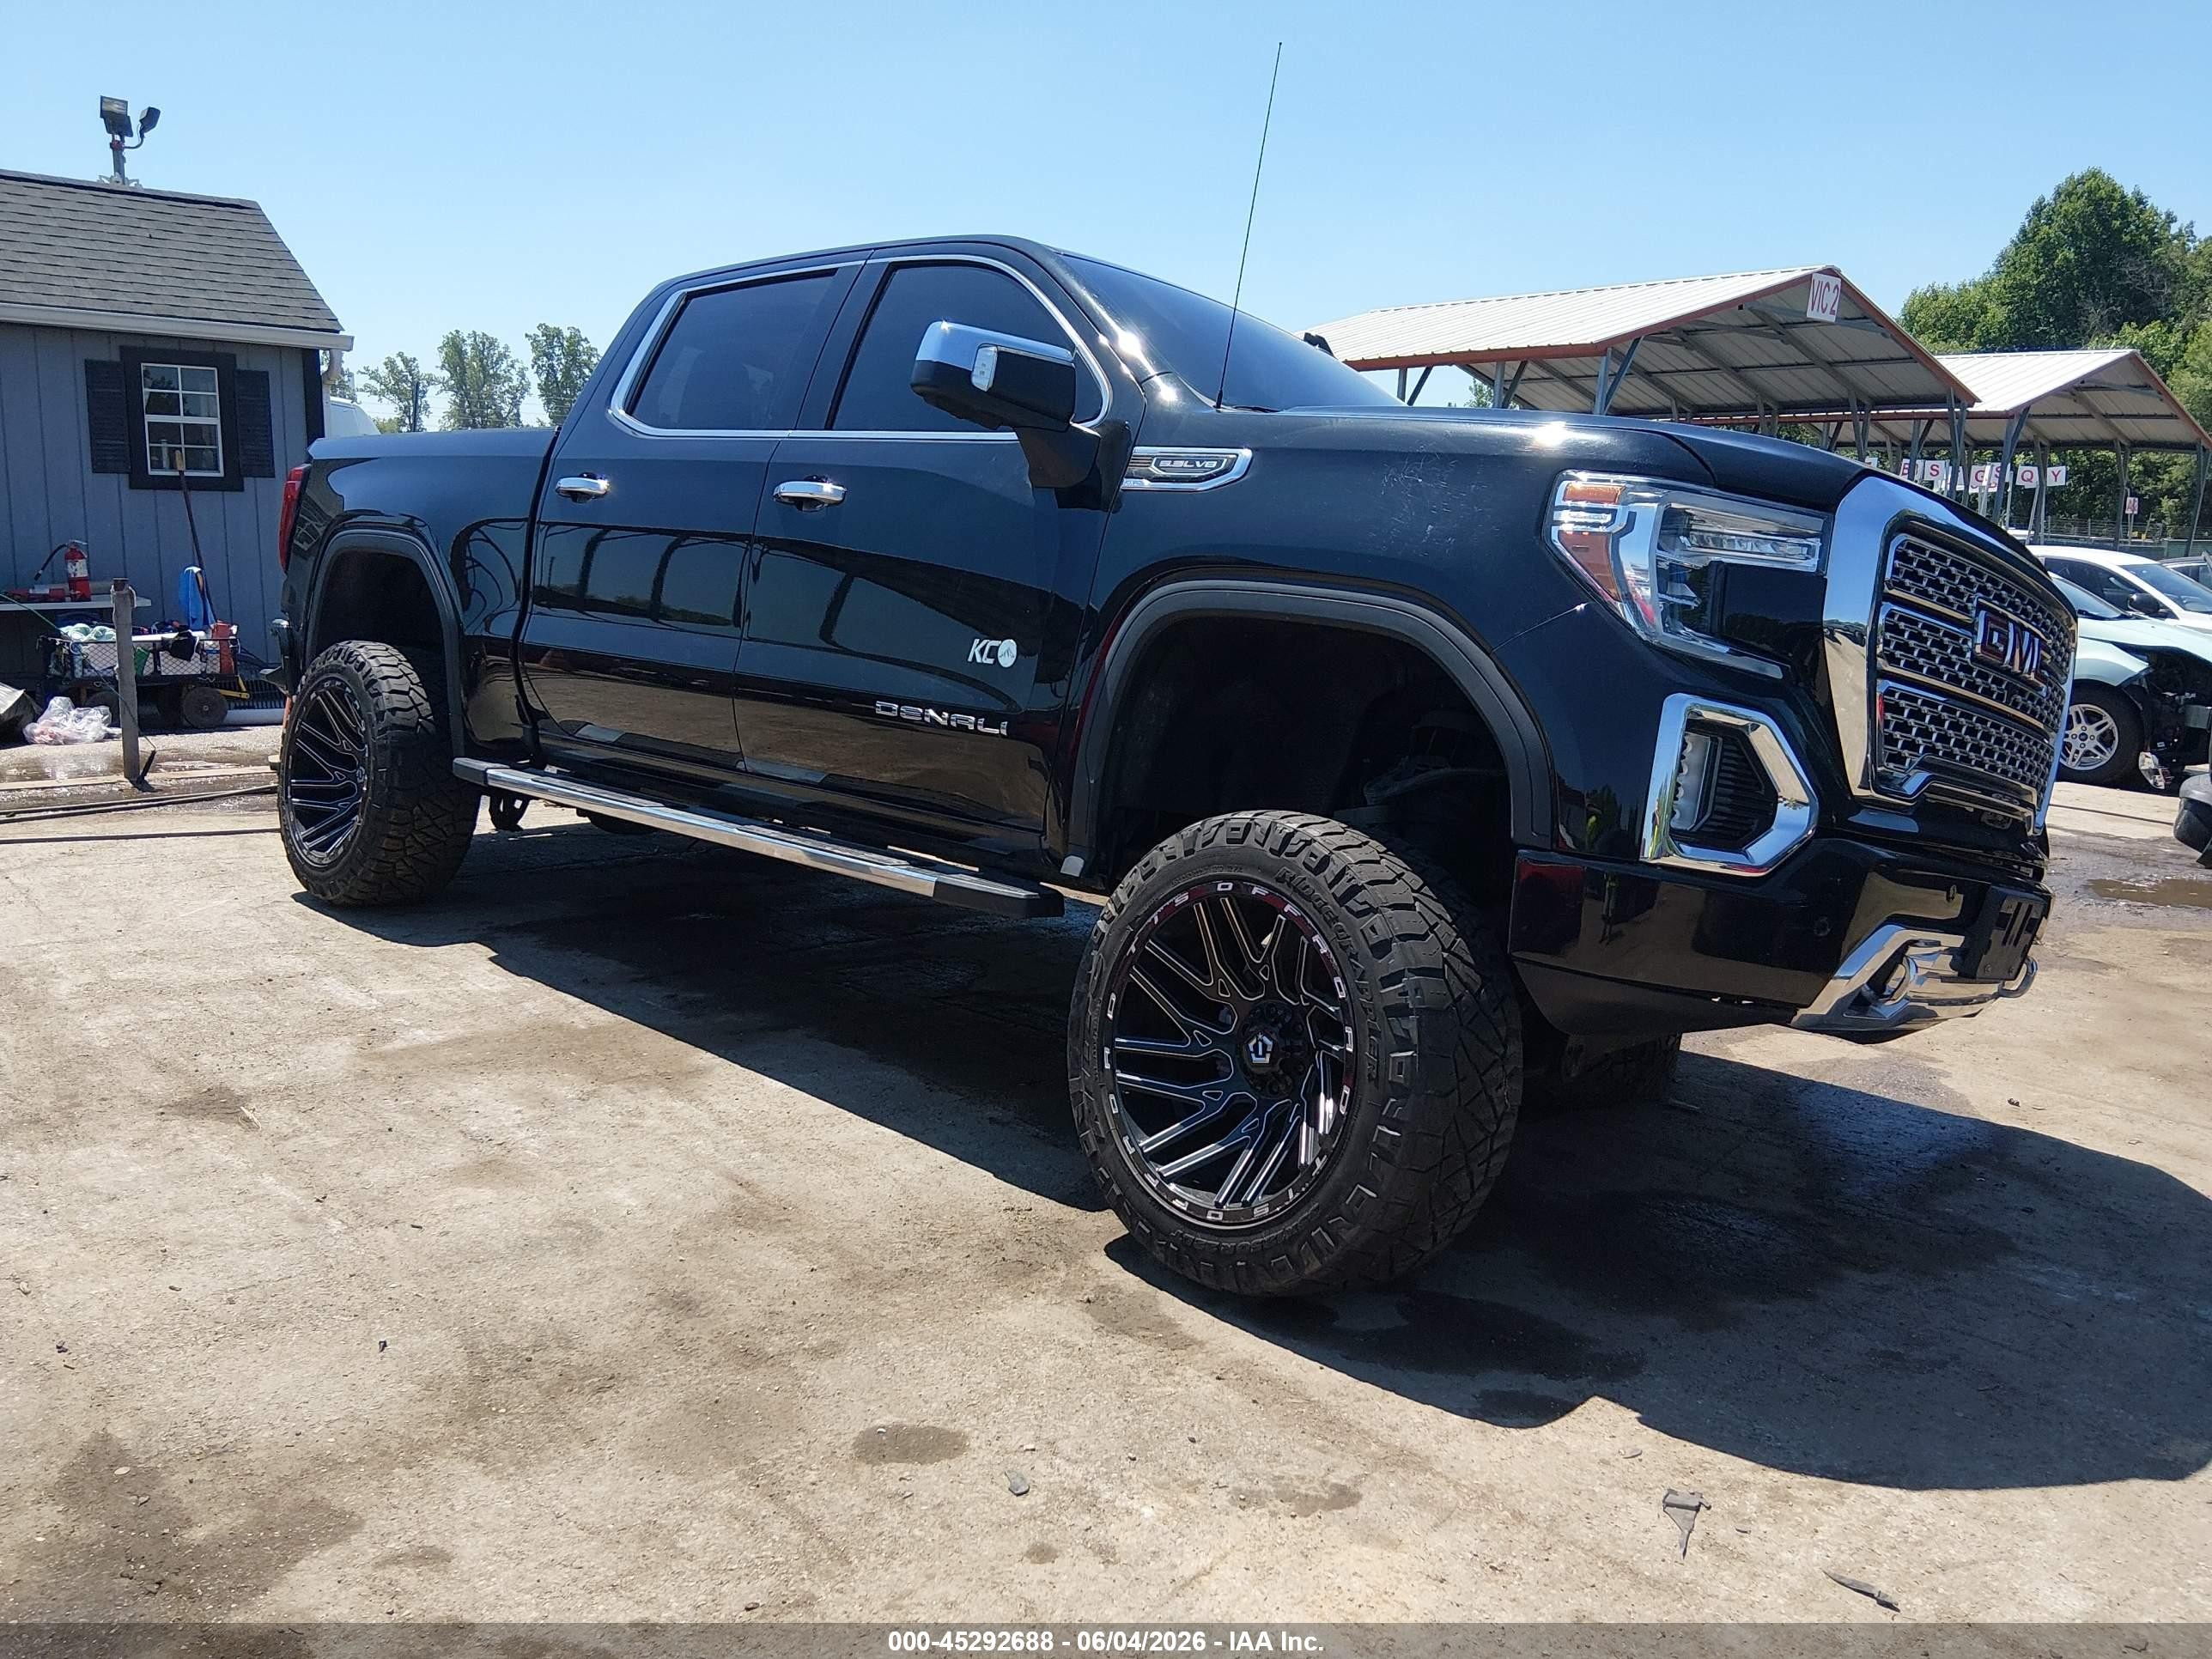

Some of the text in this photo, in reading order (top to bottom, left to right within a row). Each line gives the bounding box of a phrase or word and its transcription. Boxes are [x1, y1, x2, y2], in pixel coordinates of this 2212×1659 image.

[1811, 279, 1839, 315] VIC 2
[1929, 465, 1940, 477] S
[2021, 470, 2034, 483] Q
[2051, 470, 2061, 483] Y
[875, 701, 1009, 736] DENALI
